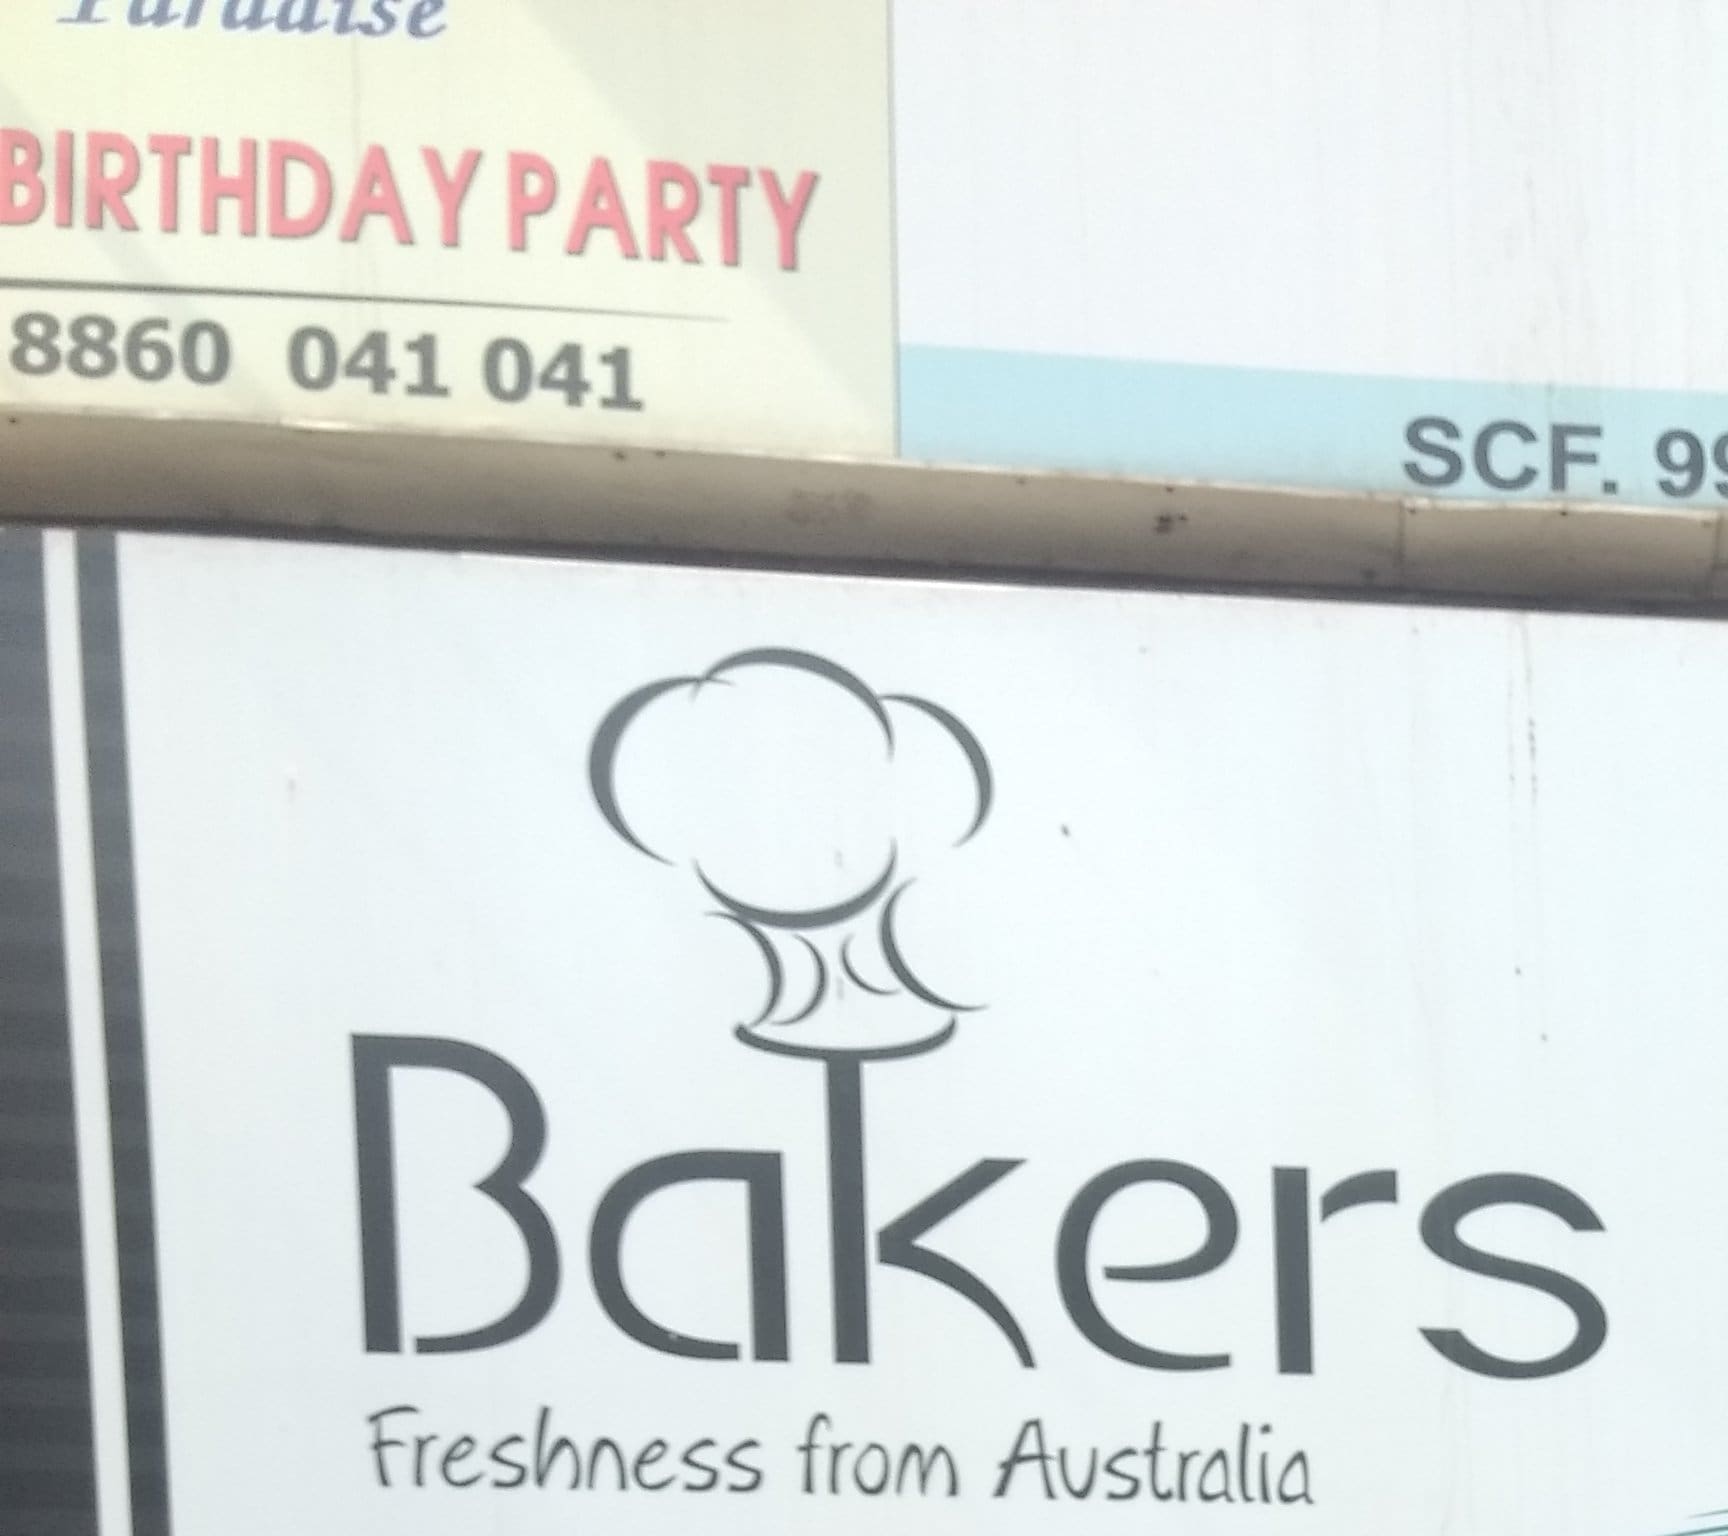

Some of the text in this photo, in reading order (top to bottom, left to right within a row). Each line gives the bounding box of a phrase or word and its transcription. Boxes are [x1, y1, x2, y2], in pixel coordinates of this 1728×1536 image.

[0, 128, 821, 272] BIRTHDAY PARTY
[9, 310, 645, 412] 8860 041 041
[1403, 416, 1618, 495] SCF.
[350, 1032, 1609, 1380] Bakers
[368, 1405, 1315, 1505] Freshness from Australia
